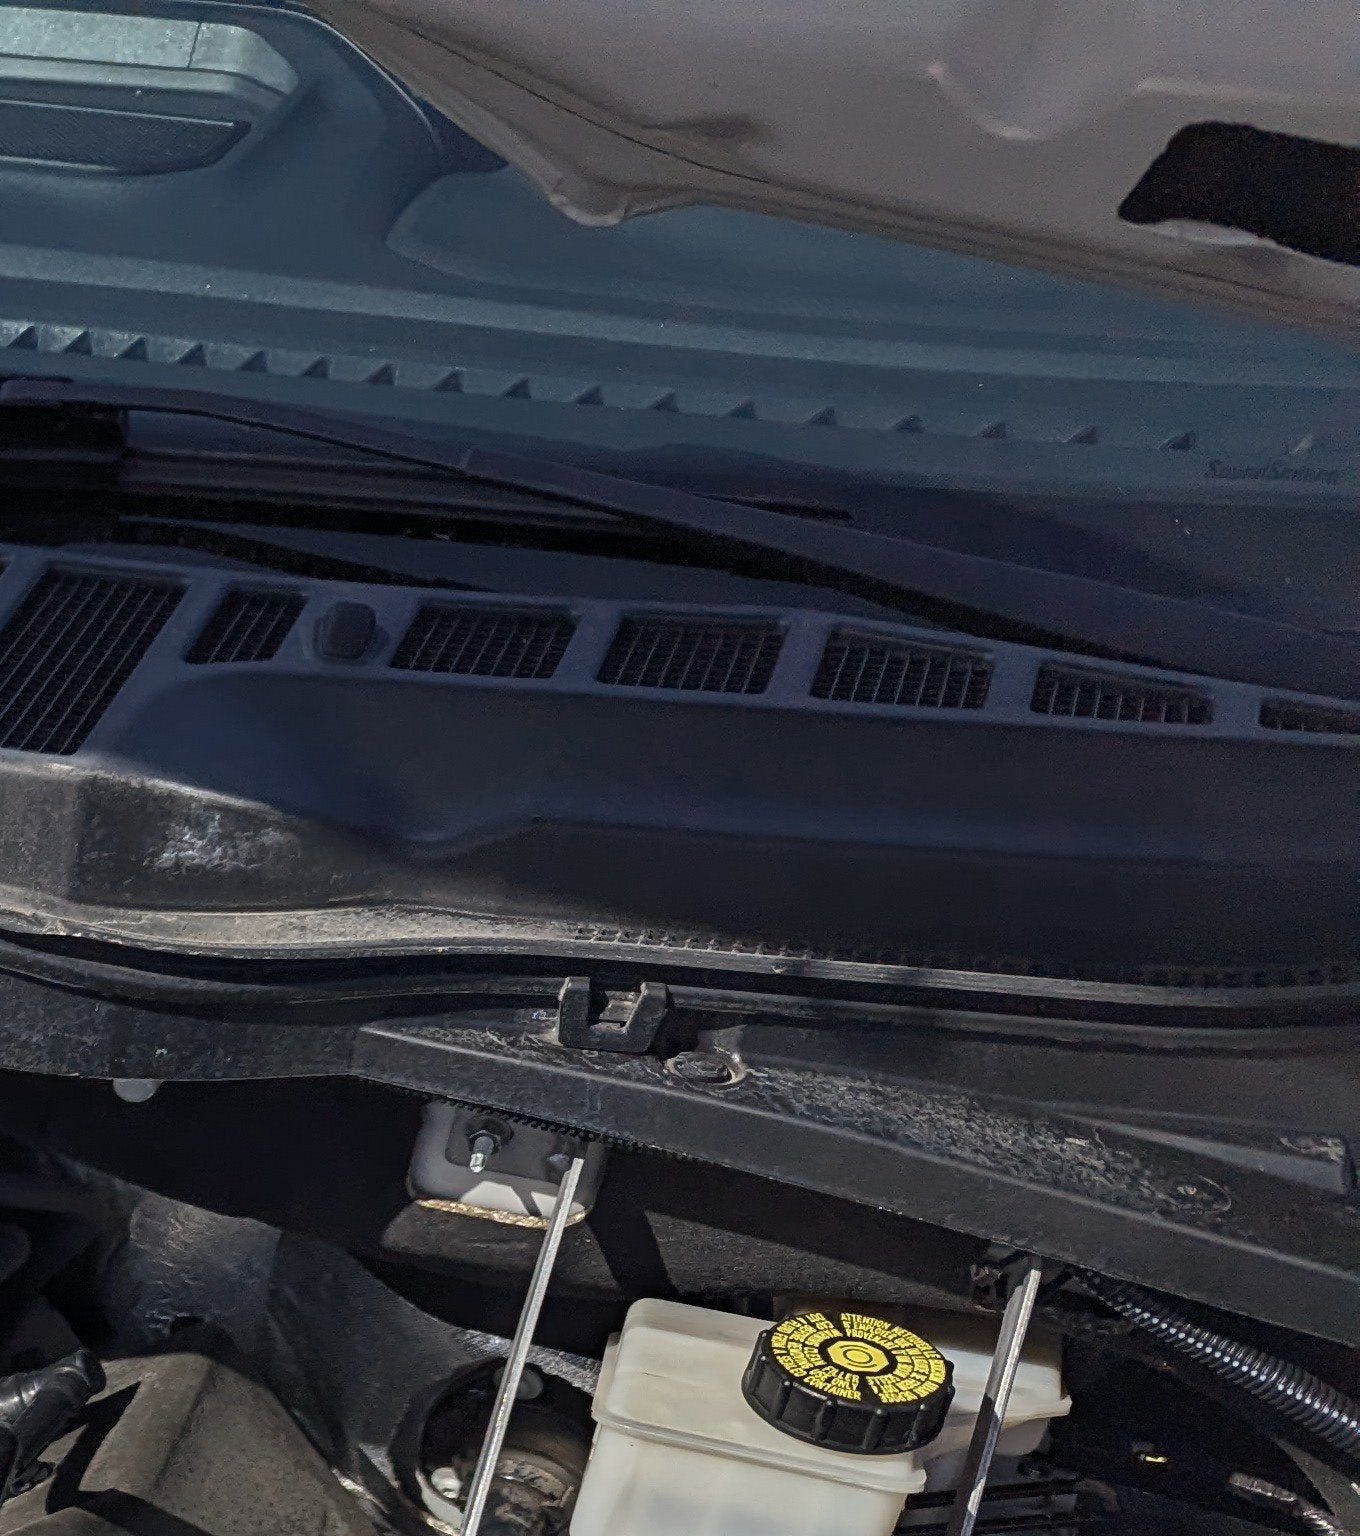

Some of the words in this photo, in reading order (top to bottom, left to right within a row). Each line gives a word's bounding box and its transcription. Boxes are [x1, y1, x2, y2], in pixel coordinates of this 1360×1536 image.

[840, 1312, 892, 1330] ATTENTION
[809, 1368, 829, 1382] USE
[830, 1377, 858, 1391] ONLY
[821, 1365, 860, 1384] FILLER
[803, 1376, 861, 1401] CONTAINER
